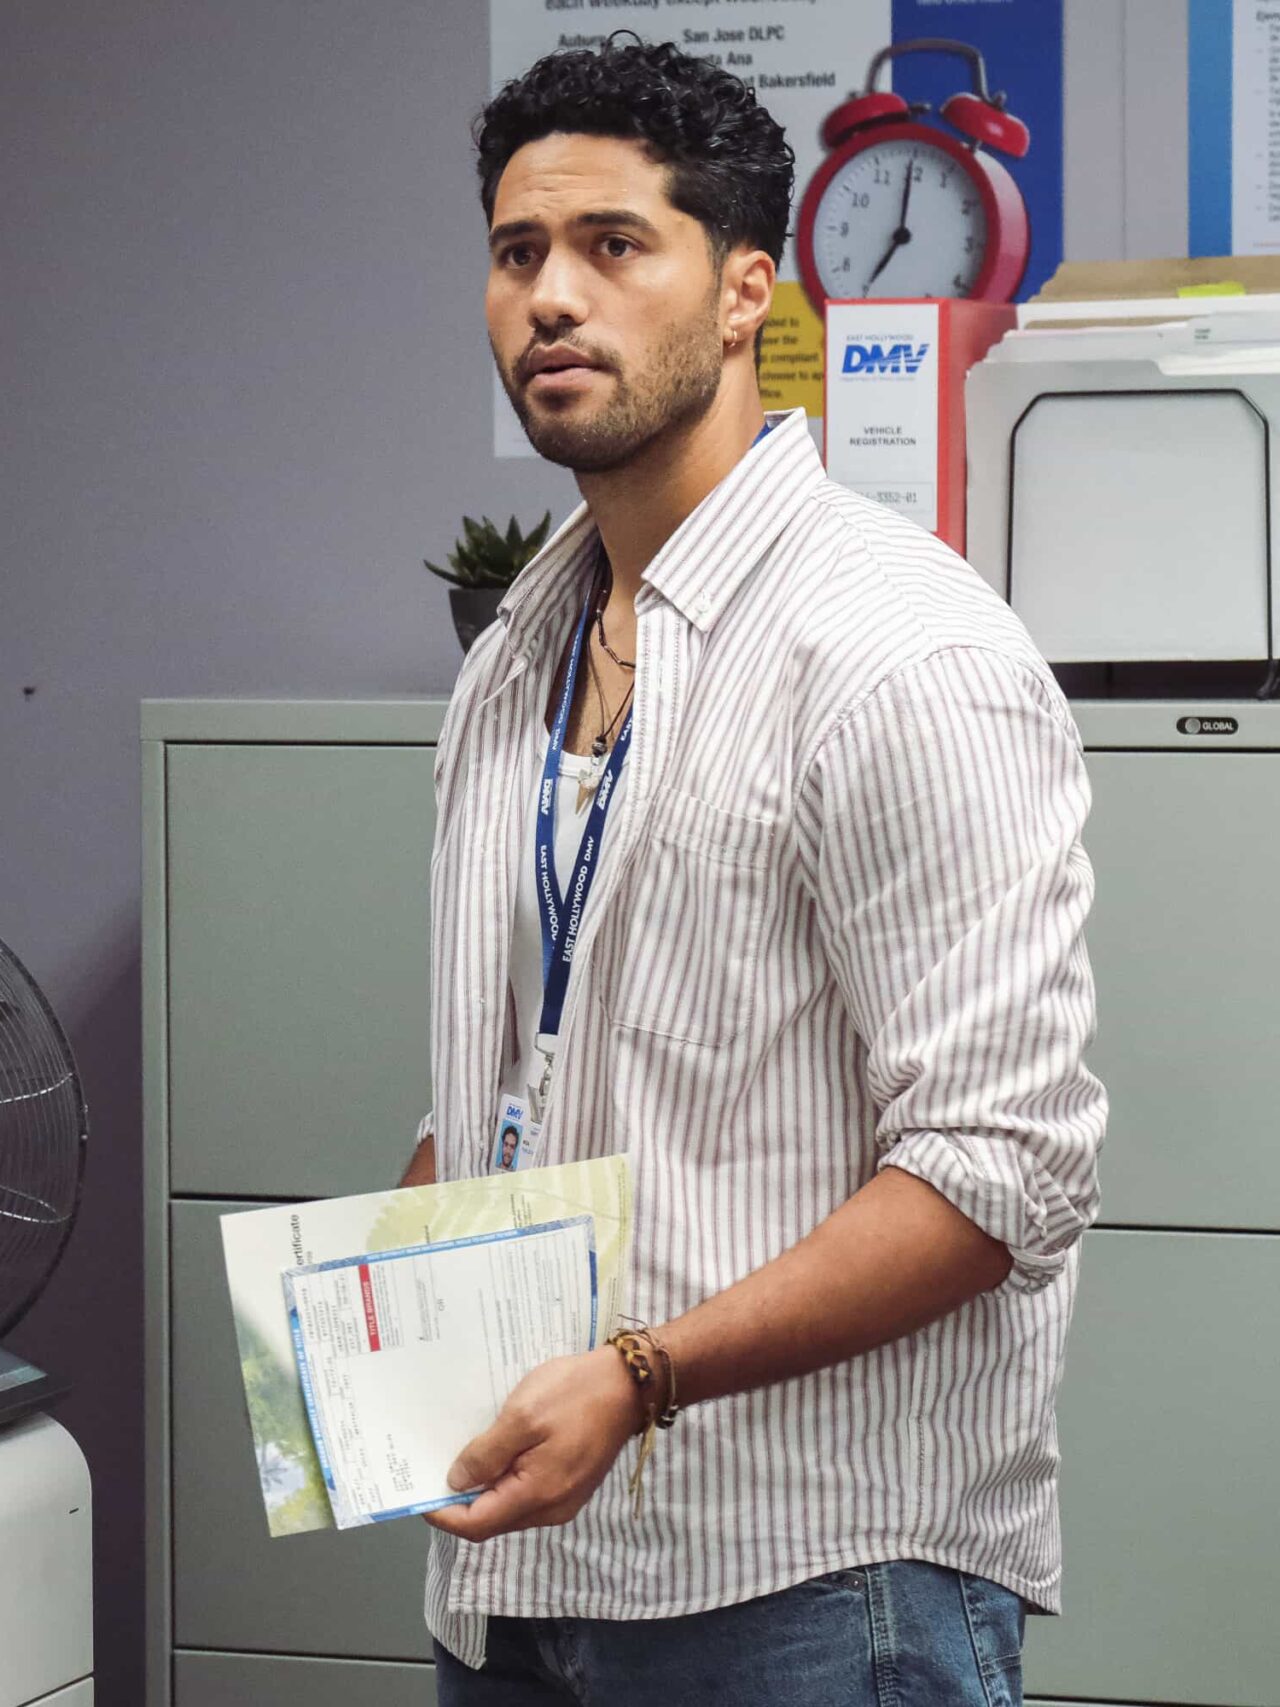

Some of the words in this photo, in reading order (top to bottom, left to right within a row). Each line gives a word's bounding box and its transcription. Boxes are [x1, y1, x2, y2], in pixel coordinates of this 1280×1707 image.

[683, 28, 710, 44] San
[713, 27, 745, 42] Jose
[748, 24, 785, 41] DLPC
[727, 51, 753, 66] Ana
[758, 71, 836, 88] Bakersfield
[852, 192, 870, 208] 10
[841, 343, 930, 374] DMV
[849, 437, 917, 447] REGISTRATION
[863, 426, 902, 435] VEHICLE
[1202, 721, 1233, 731] GLOBAL
[541, 778, 553, 815] DMV
[596, 769, 613, 810] DMV
[540, 844, 548, 870] EAST
[584, 836, 595, 862] DMV
[568, 865, 588, 936] HOLLYWOOD
[563, 936, 577, 962] EAST
[290, 1213, 305, 1266] ertificate
